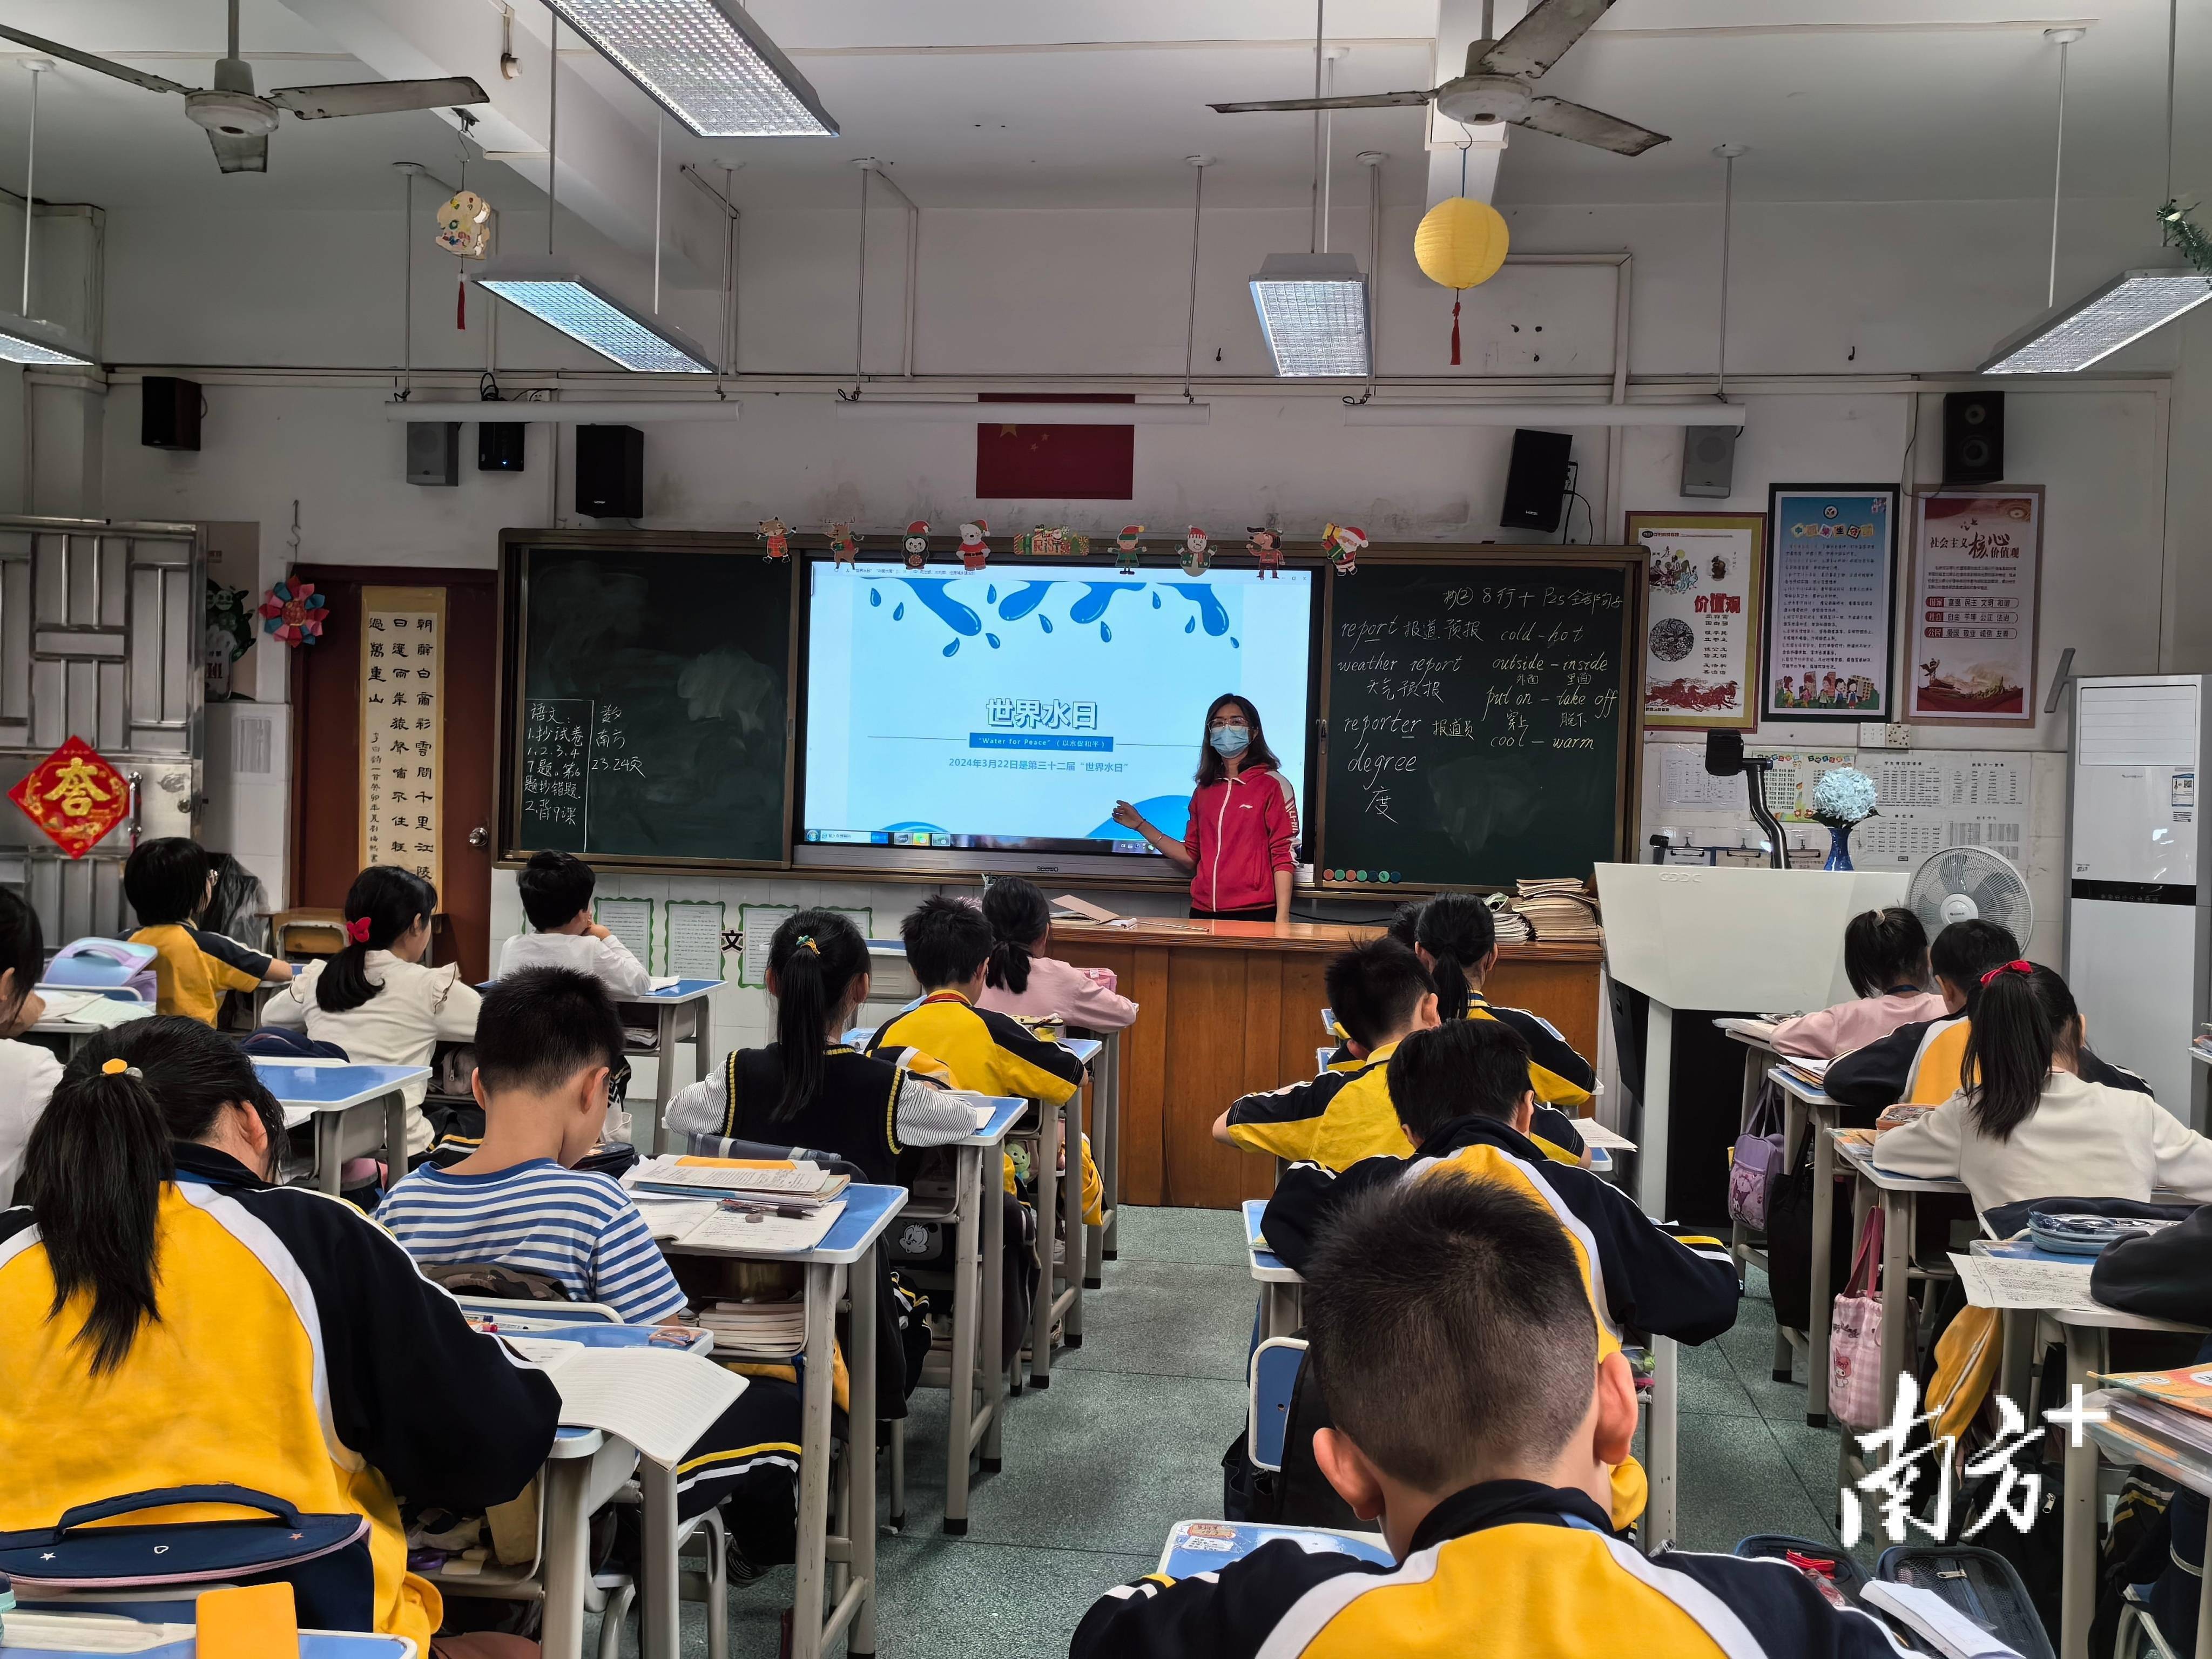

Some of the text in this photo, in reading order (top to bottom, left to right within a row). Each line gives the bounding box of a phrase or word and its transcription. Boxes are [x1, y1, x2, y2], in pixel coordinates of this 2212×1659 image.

[1930, 531, 2010, 559] 社会主义 核心
[1991, 547, 2019, 558] 价值观
[1341, 616, 1399, 653] report
[1928, 629, 1941, 637] 公民
[1338, 651, 1463, 685] weather report
[1492, 655, 1545, 671] outside
[1562, 652, 1608, 671] inside
[1366, 678, 1444, 703] 天气预报
[1516, 673, 1539, 686] 外面
[1567, 673, 1592, 686] 里面
[986, 698, 1098, 730] 世界水日
[1481, 686, 1509, 721] put
[1516, 693, 1533, 705] on
[1558, 687, 1586, 705] take
[1594, 689, 1618, 719] off
[1344, 709, 1475, 750] reporter 报道员
[1507, 710, 1529, 730] 穿上
[1559, 712, 1587, 727] 脱下
[1491, 730, 1526, 748] cool
[1553, 738, 1595, 750] warm
[1347, 744, 1418, 790] degree
[43, 757, 111, 817] 春
[1365, 787, 1399, 825] 度
[721, 929, 743, 953] 文
